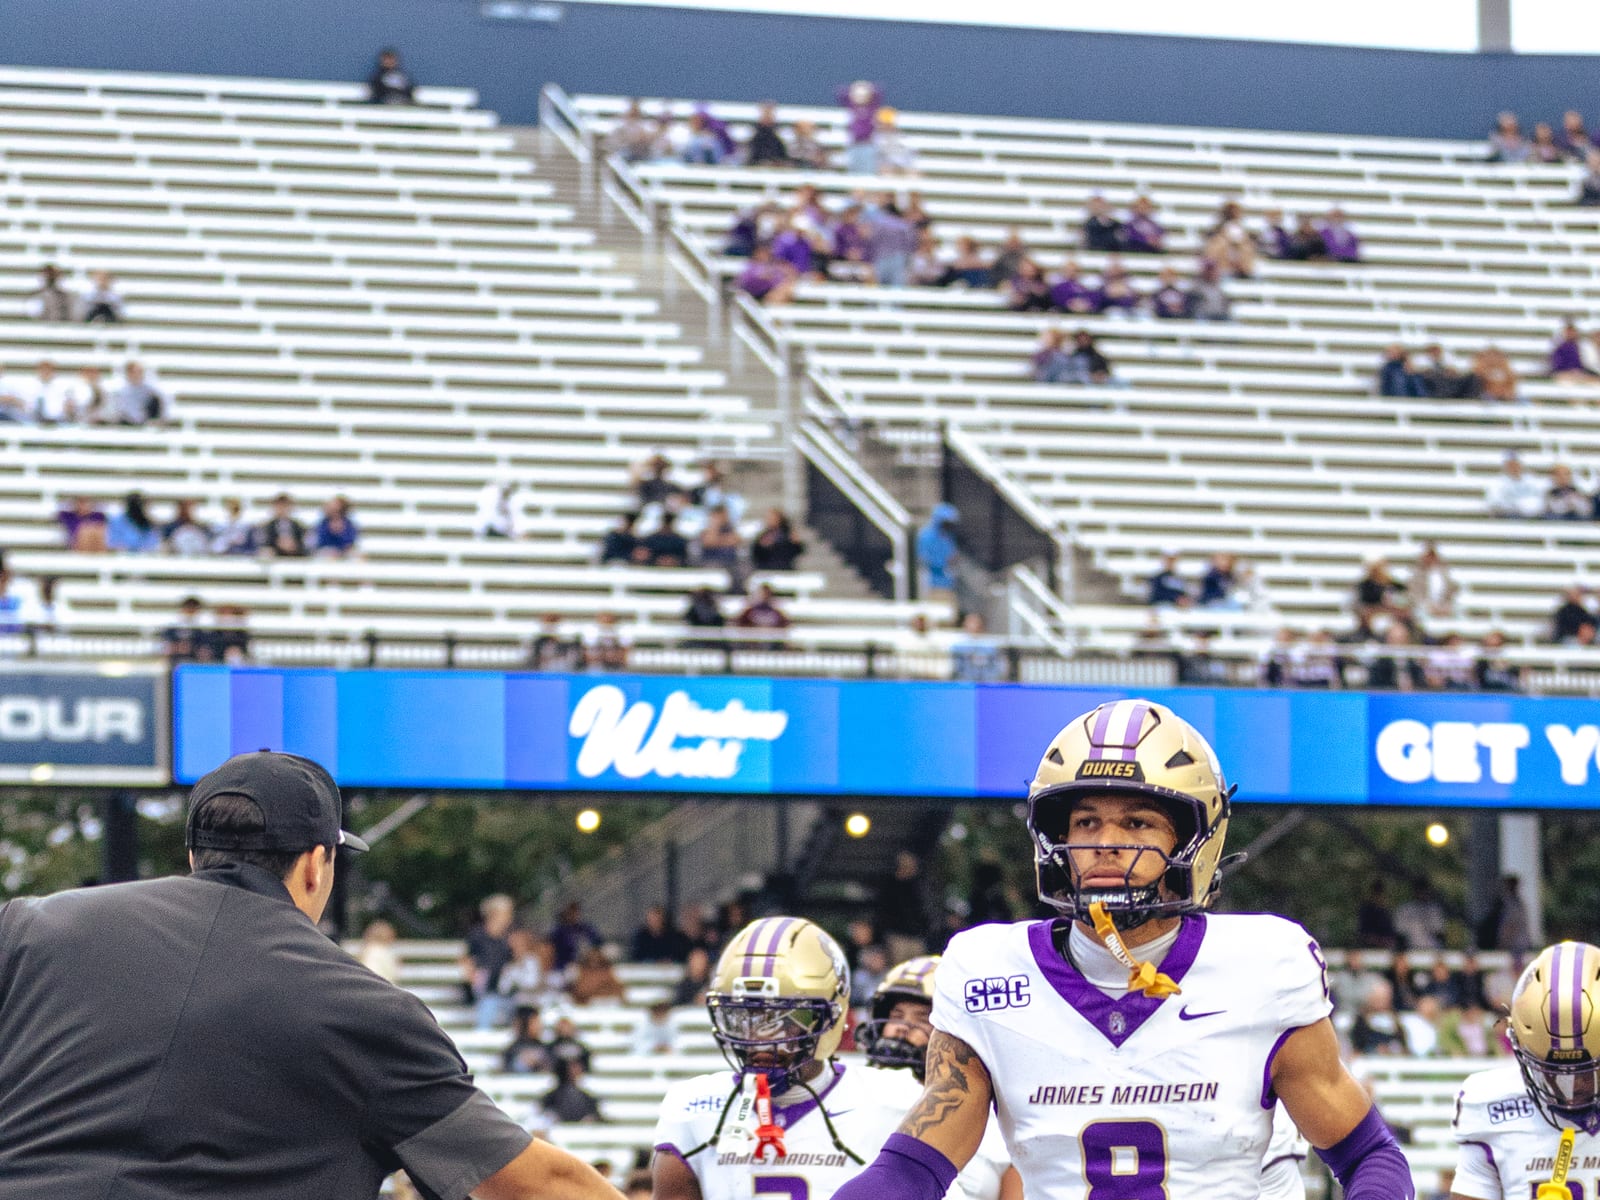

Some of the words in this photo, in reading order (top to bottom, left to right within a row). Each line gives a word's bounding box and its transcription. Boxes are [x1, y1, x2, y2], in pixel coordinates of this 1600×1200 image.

[0, 697, 142, 743] OUR
[1376, 719, 1530, 784] GET
[1545, 724, 1600, 785] Y
[1082, 762, 1136, 777] DUKES
[964, 974, 1031, 1013] SBC
[1029, 1086, 1104, 1105] JAMES
[1110, 1082, 1218, 1105] MADISON
[1487, 1096, 1534, 1125] SBC
[773, 1153, 847, 1167] MADISON
[1583, 1156, 1600, 1170] M
